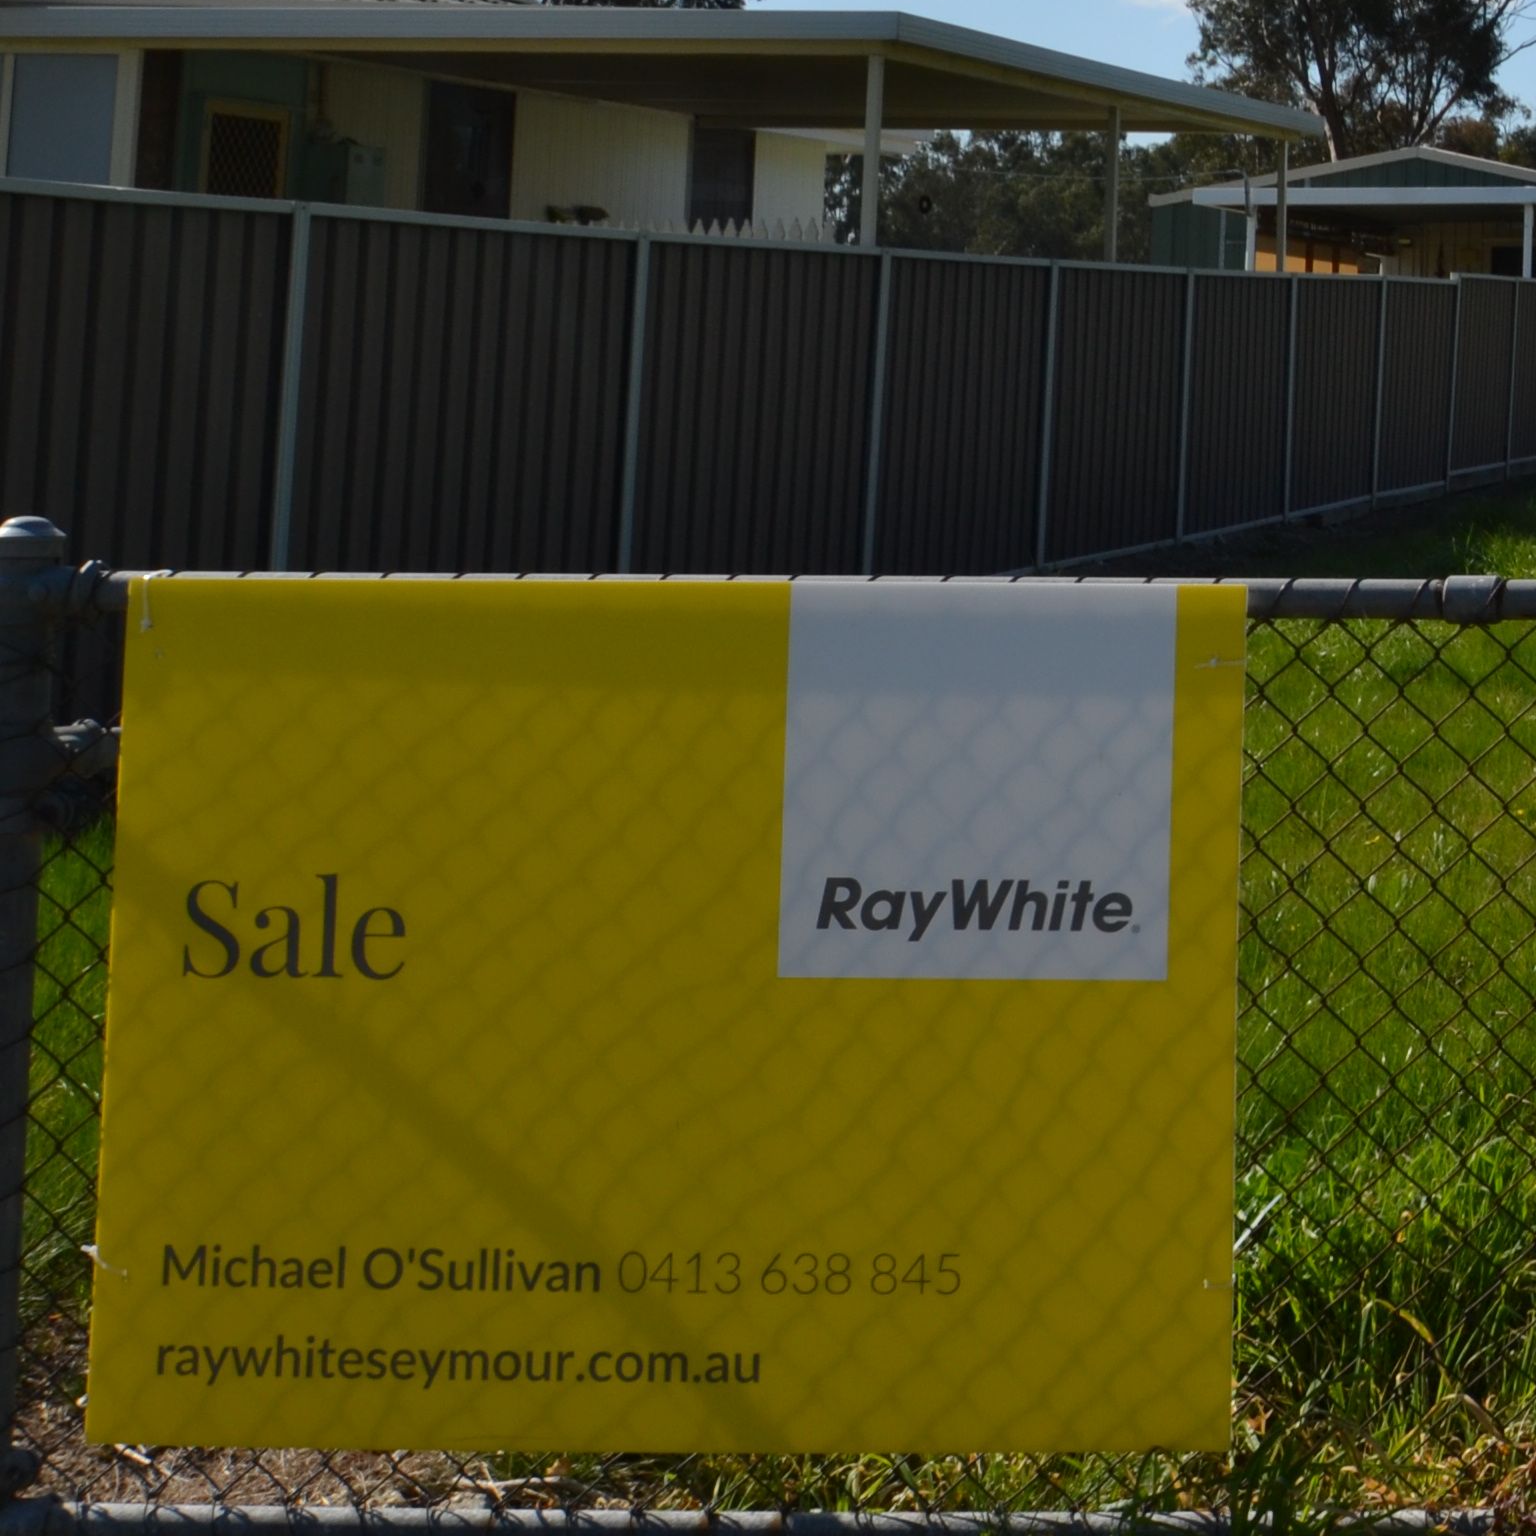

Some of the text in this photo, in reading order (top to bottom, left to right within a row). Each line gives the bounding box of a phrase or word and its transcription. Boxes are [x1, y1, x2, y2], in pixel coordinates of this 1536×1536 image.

[181, 872, 406, 981] Sale
[160, 1243, 961, 1296] Michael O'Sullivan 0413 638 845
[155, 1333, 761, 1391] raywhiteseymour.com.au
